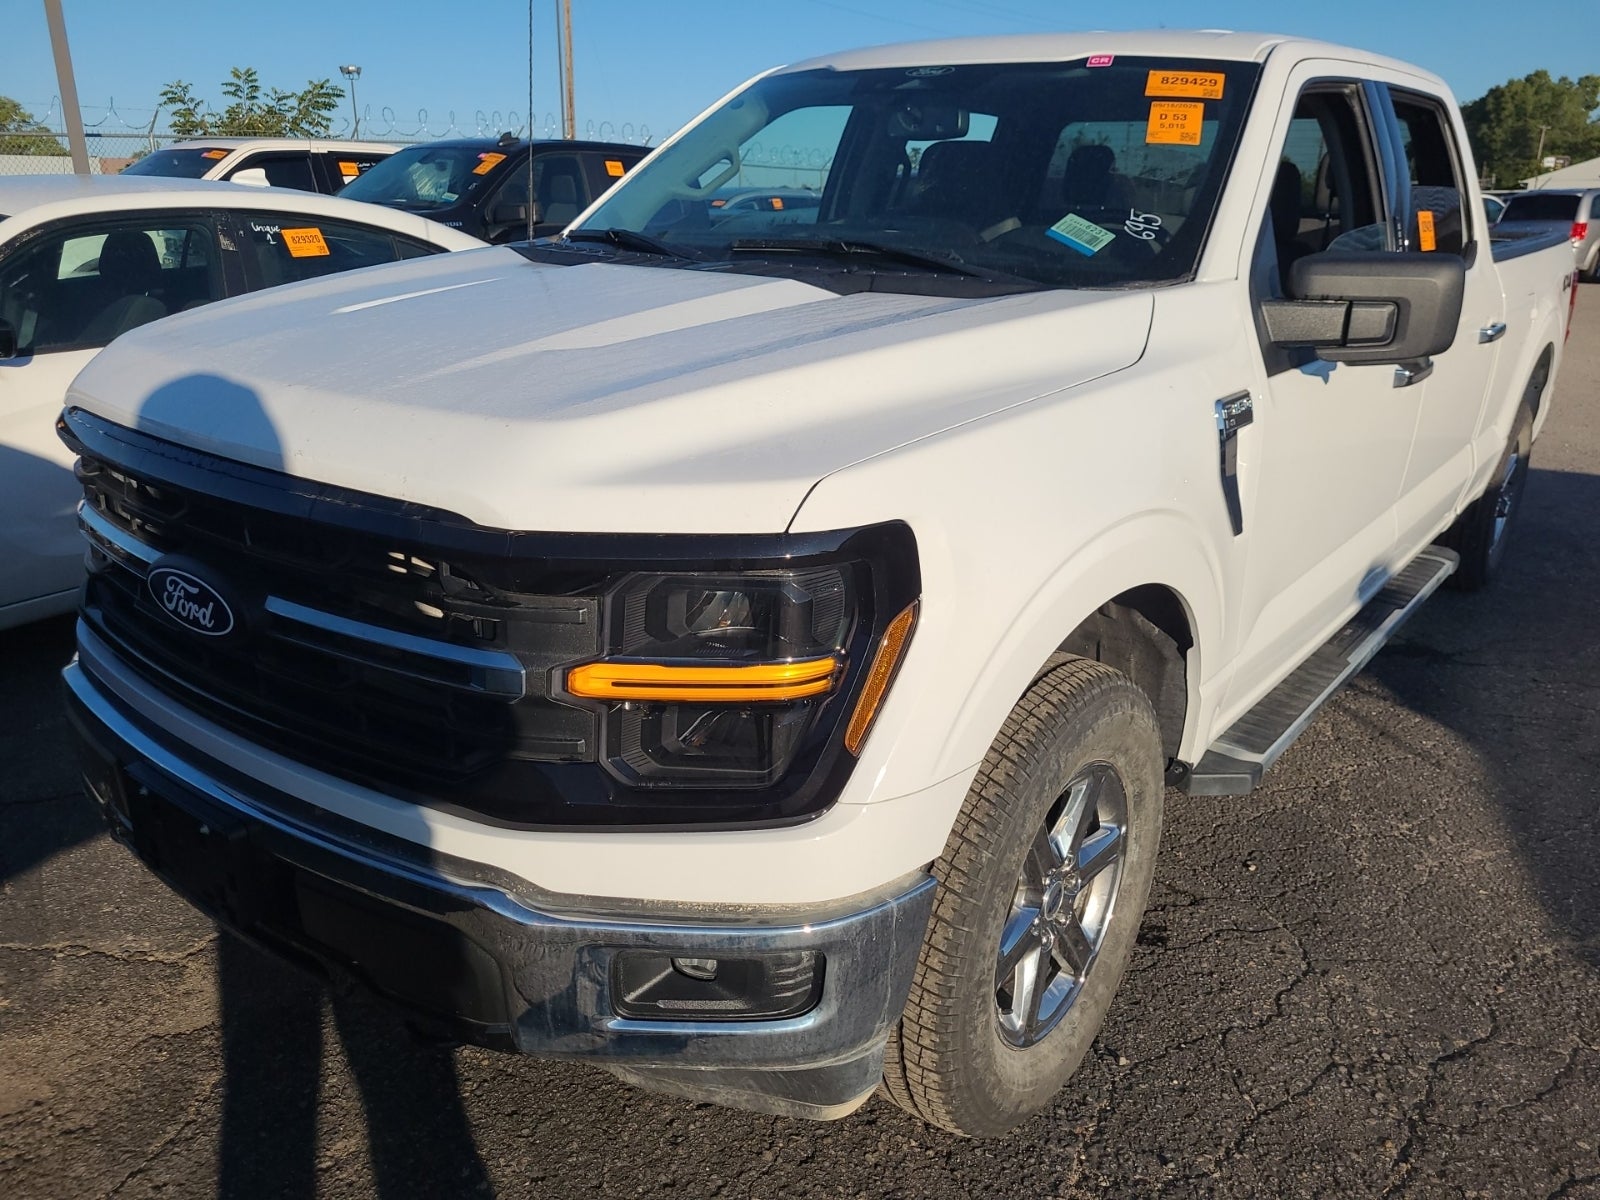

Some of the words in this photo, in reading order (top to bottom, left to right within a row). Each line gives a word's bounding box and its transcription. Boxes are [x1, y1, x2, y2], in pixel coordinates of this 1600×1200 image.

[1160, 76, 1218, 87] 829429
[1172, 113, 1187, 121] 53
[1124, 208, 1161, 240] 695
[163, 575, 215, 628] Ford
